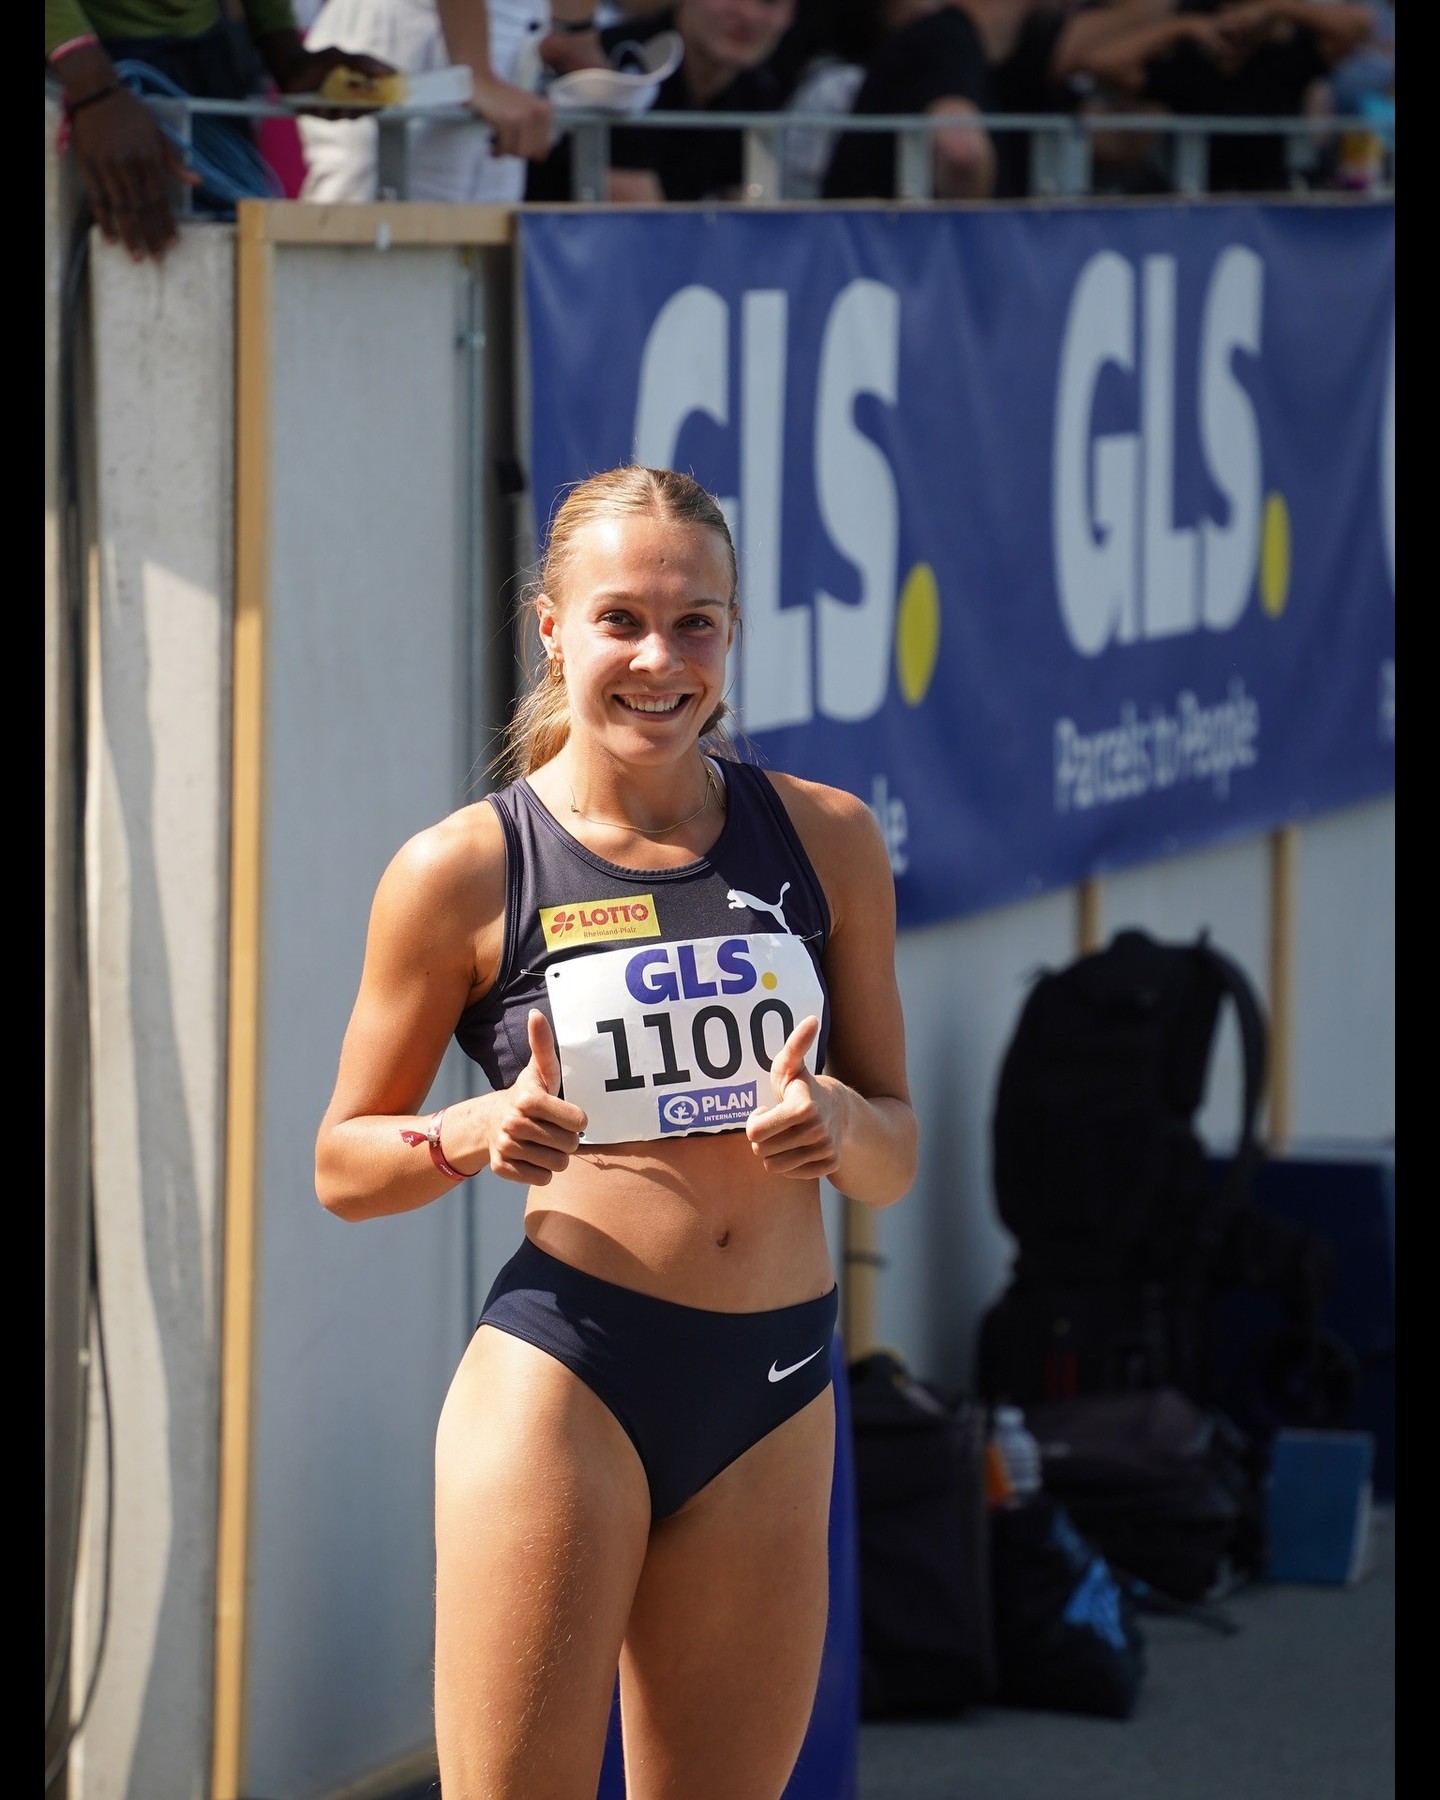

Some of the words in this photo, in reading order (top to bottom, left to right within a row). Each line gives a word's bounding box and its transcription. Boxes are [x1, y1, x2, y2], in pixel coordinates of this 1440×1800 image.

[1053, 244, 1290, 656] GLS.
[579, 903, 649, 927] LOTTO
[583, 927, 637, 938] Rheinland-Pfalz
[625, 938, 778, 1005] GLS.
[596, 998, 795, 1092] 1100
[701, 1090, 754, 1113] PLAN
[704, 1110, 752, 1122] INTERNATIONA
